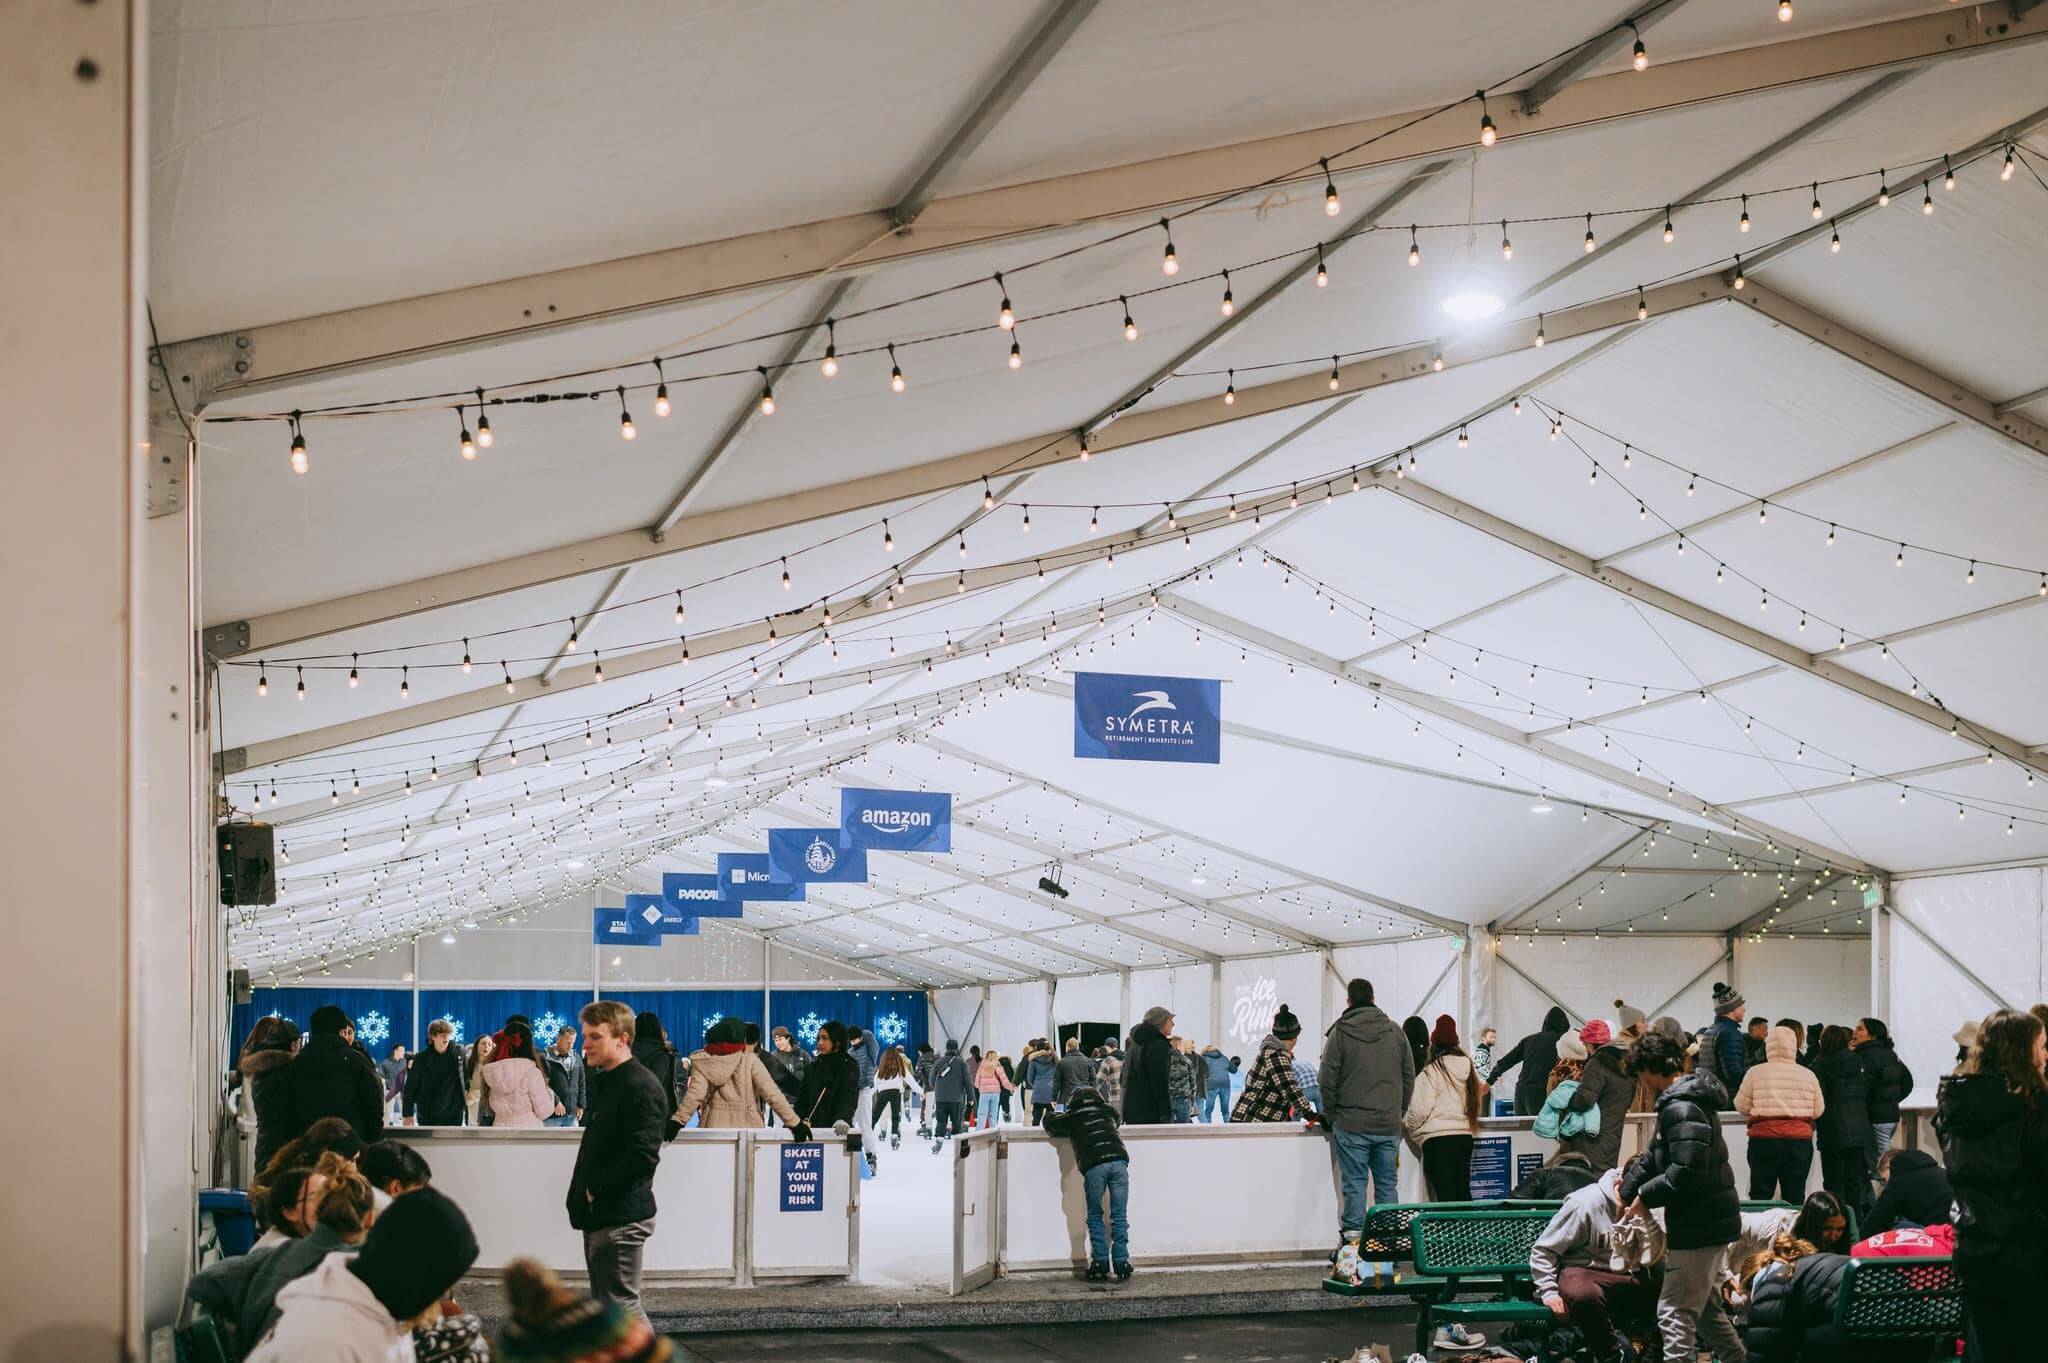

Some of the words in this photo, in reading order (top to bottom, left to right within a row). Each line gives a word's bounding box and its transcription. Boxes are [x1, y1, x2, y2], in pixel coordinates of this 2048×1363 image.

[1105, 716, 1193, 735] SYMETRA
[1105, 735, 1143, 743] RETIREMENT
[862, 809, 931, 826] amazon
[747, 871, 770, 882] Micr
[784, 1148, 821, 1158] SKATE
[794, 1160, 810, 1169] AT
[787, 1172, 817, 1181] YOUR
[789, 1183, 815, 1193] OWN
[788, 1195, 816, 1205] RISK
